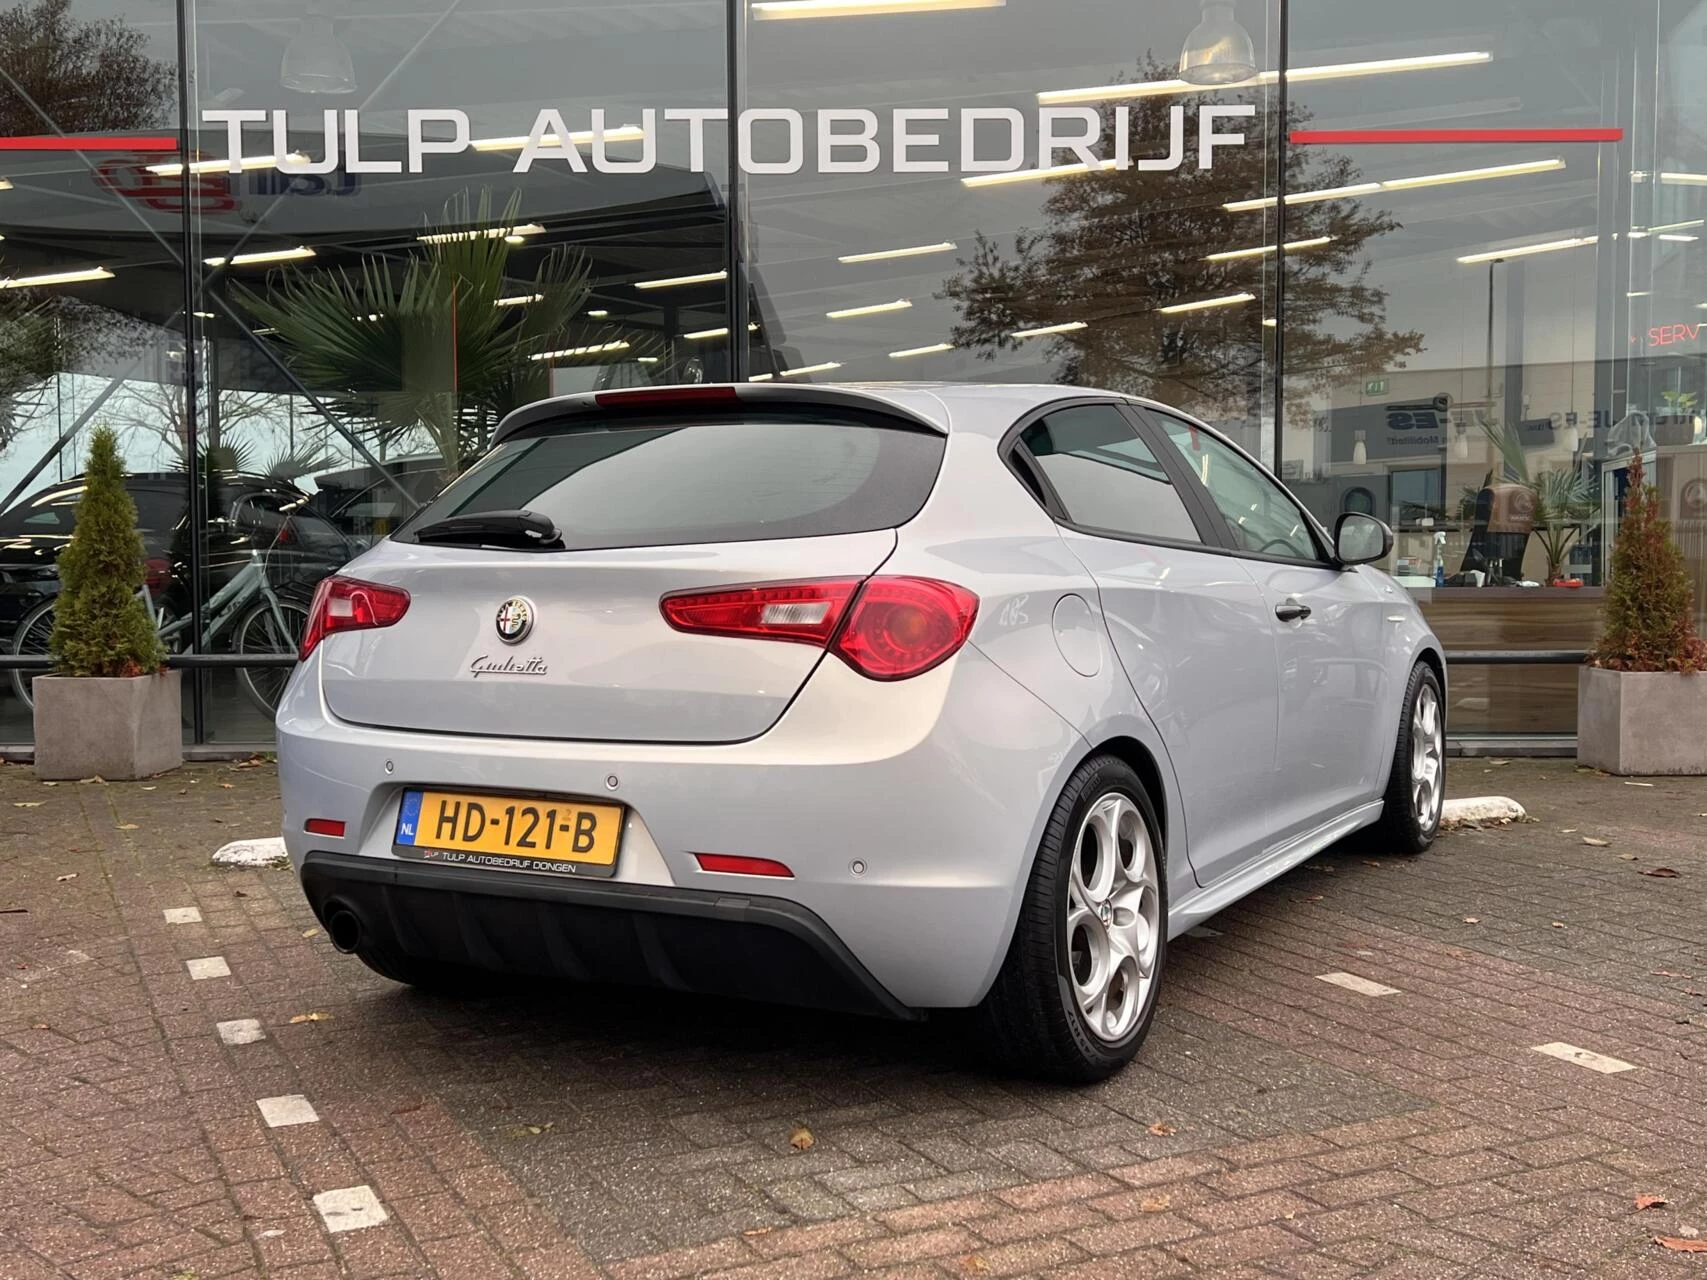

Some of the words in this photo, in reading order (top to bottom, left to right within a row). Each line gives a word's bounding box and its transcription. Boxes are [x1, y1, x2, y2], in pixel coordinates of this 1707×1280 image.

[202, 109, 470, 174] TULP
[512, 105, 1256, 174] AUTOBEDRIJF
[470, 655, 548, 679] Giulietta
[401, 823, 414, 836] NL
[435, 800, 598, 853] HD-121-B
[442, 852, 465, 863] TULP
[467, 855, 531, 870] AUTOBEDRIJF
[533, 861, 576, 874] DONGEN
